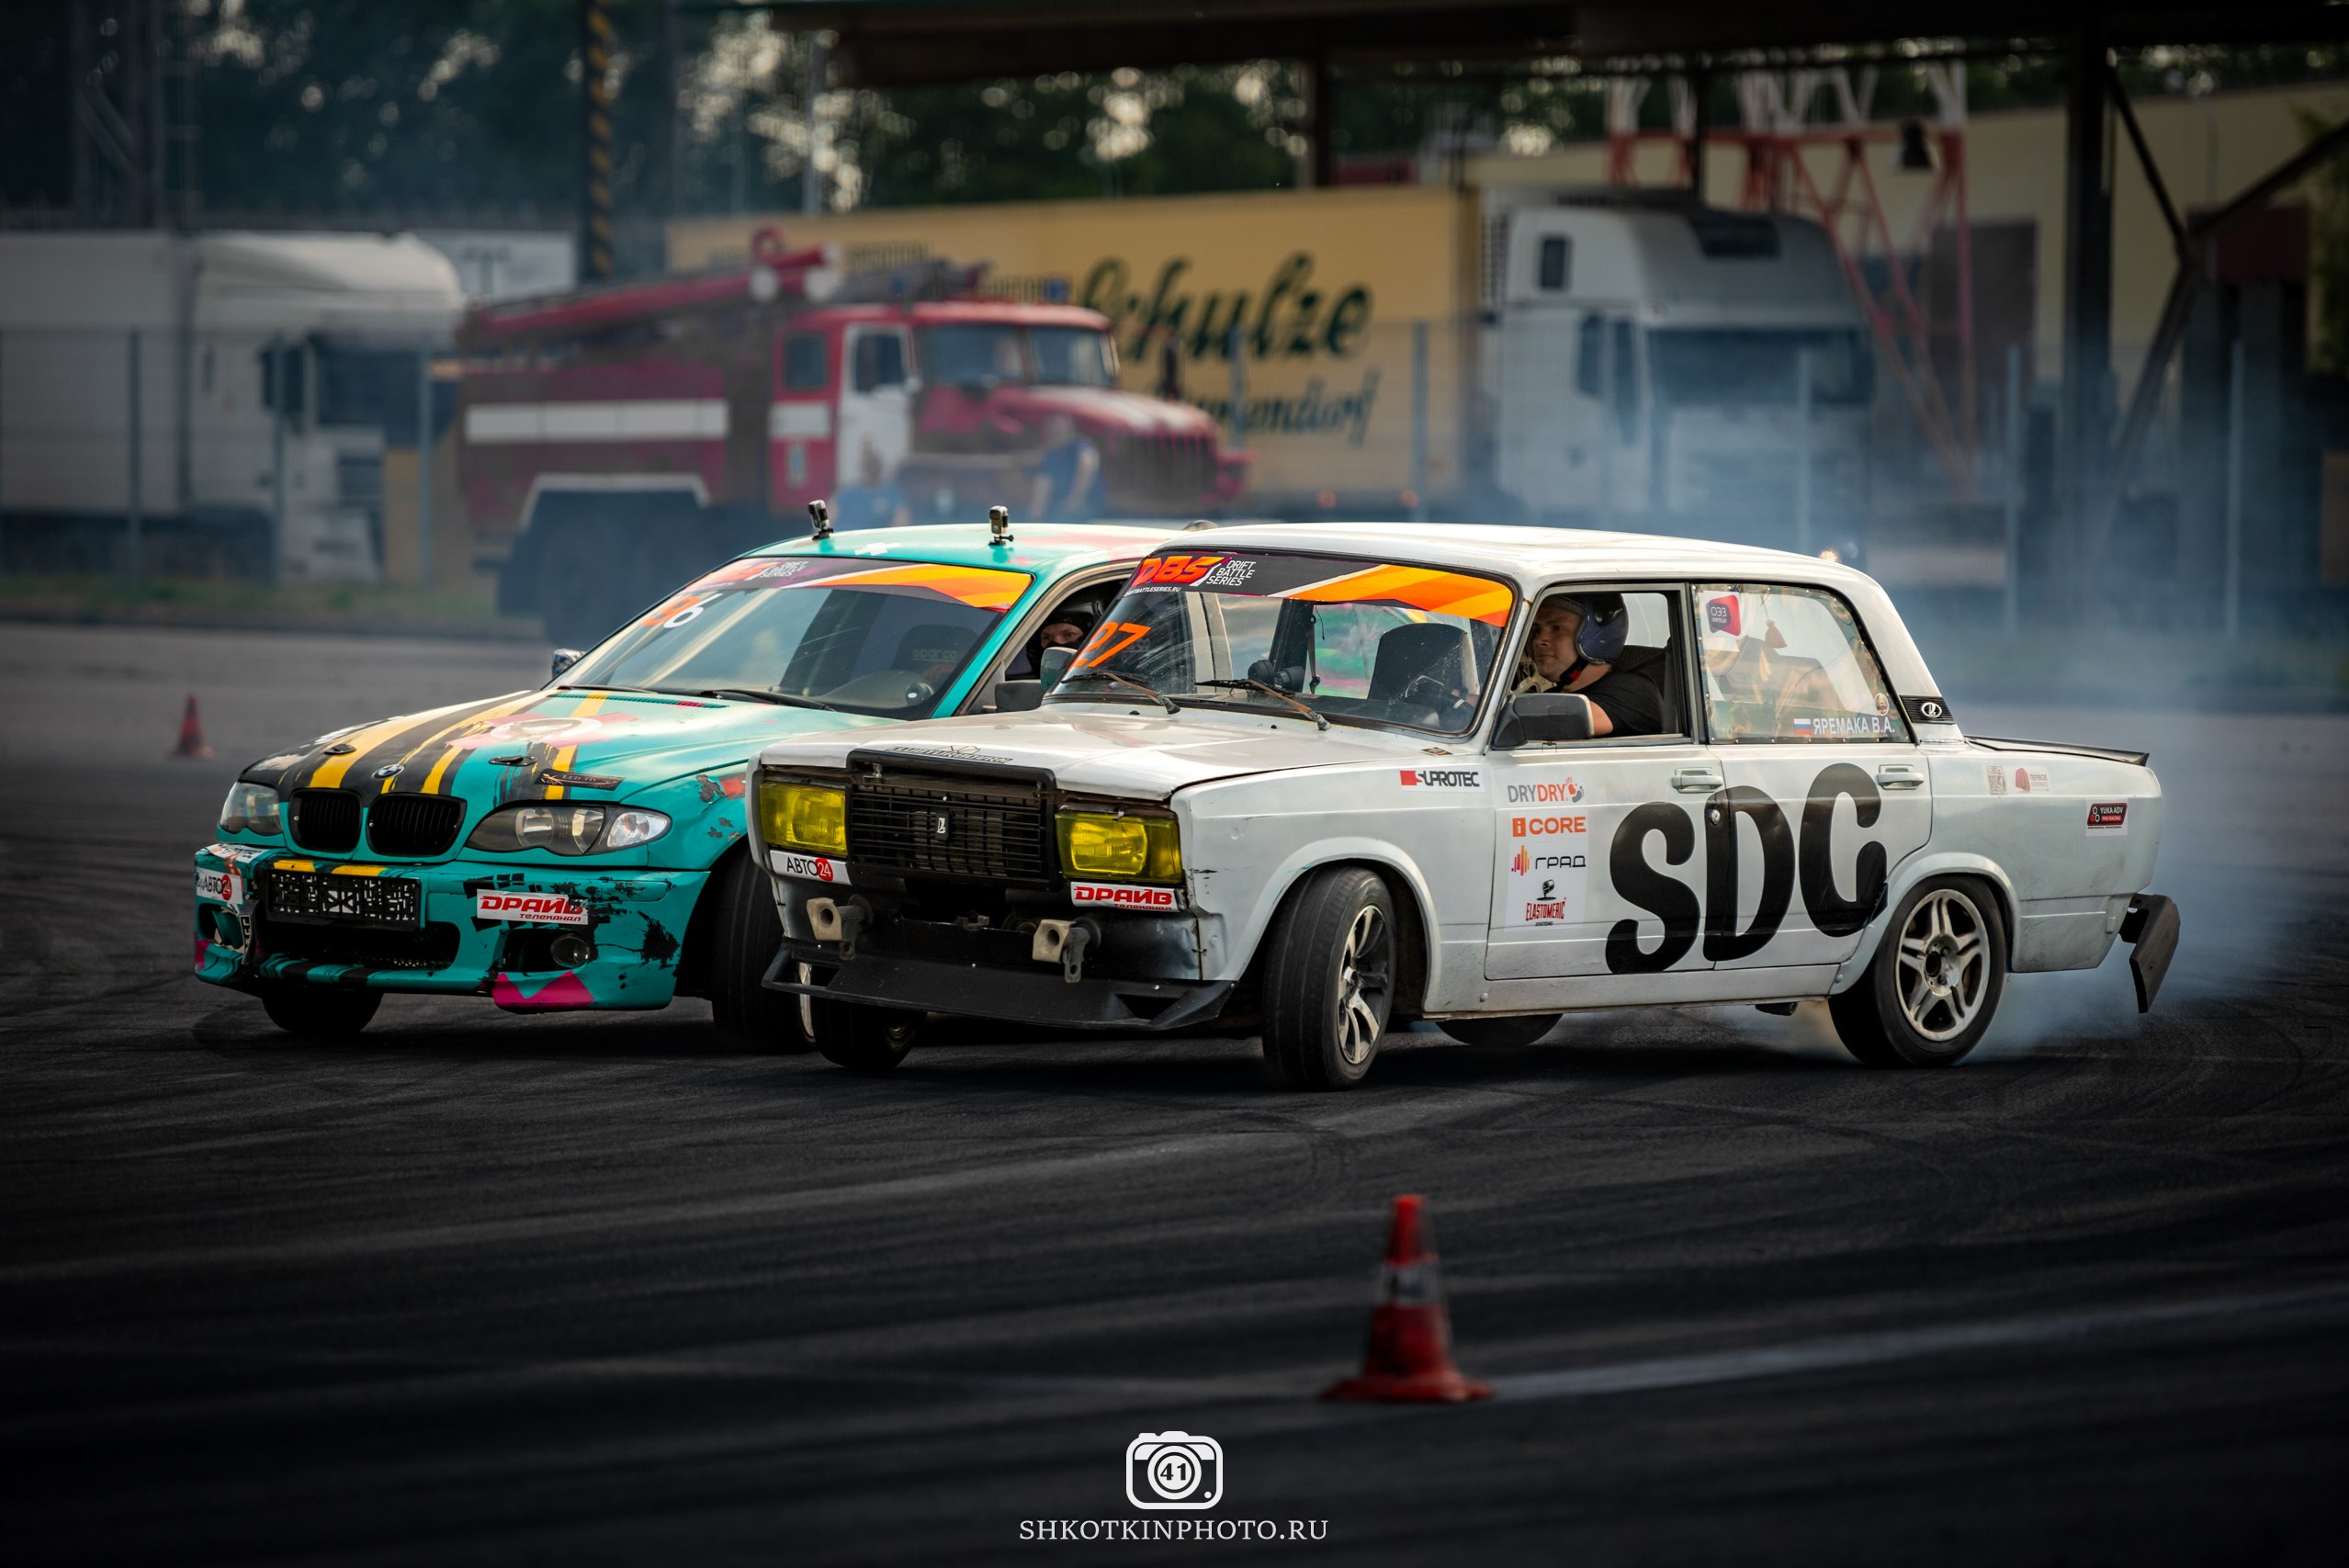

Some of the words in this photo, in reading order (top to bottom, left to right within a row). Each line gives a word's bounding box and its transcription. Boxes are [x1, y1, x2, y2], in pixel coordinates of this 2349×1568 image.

[1130, 556, 1225, 588] DBS
[1226, 560, 1256, 570] DRIFT
[1216, 568, 1255, 579] BATTLE
[1206, 576, 1244, 586] SERIES
[912, 649, 957, 659] sparco
[1813, 716, 1869, 735] ЯРЕМАКА
[1871, 716, 1896, 733] В.А.
[1508, 784, 1565, 802] DRYDRY
[1535, 855, 1587, 869] ГРАД
[1526, 900, 1565, 921] ELASTOMERIC
